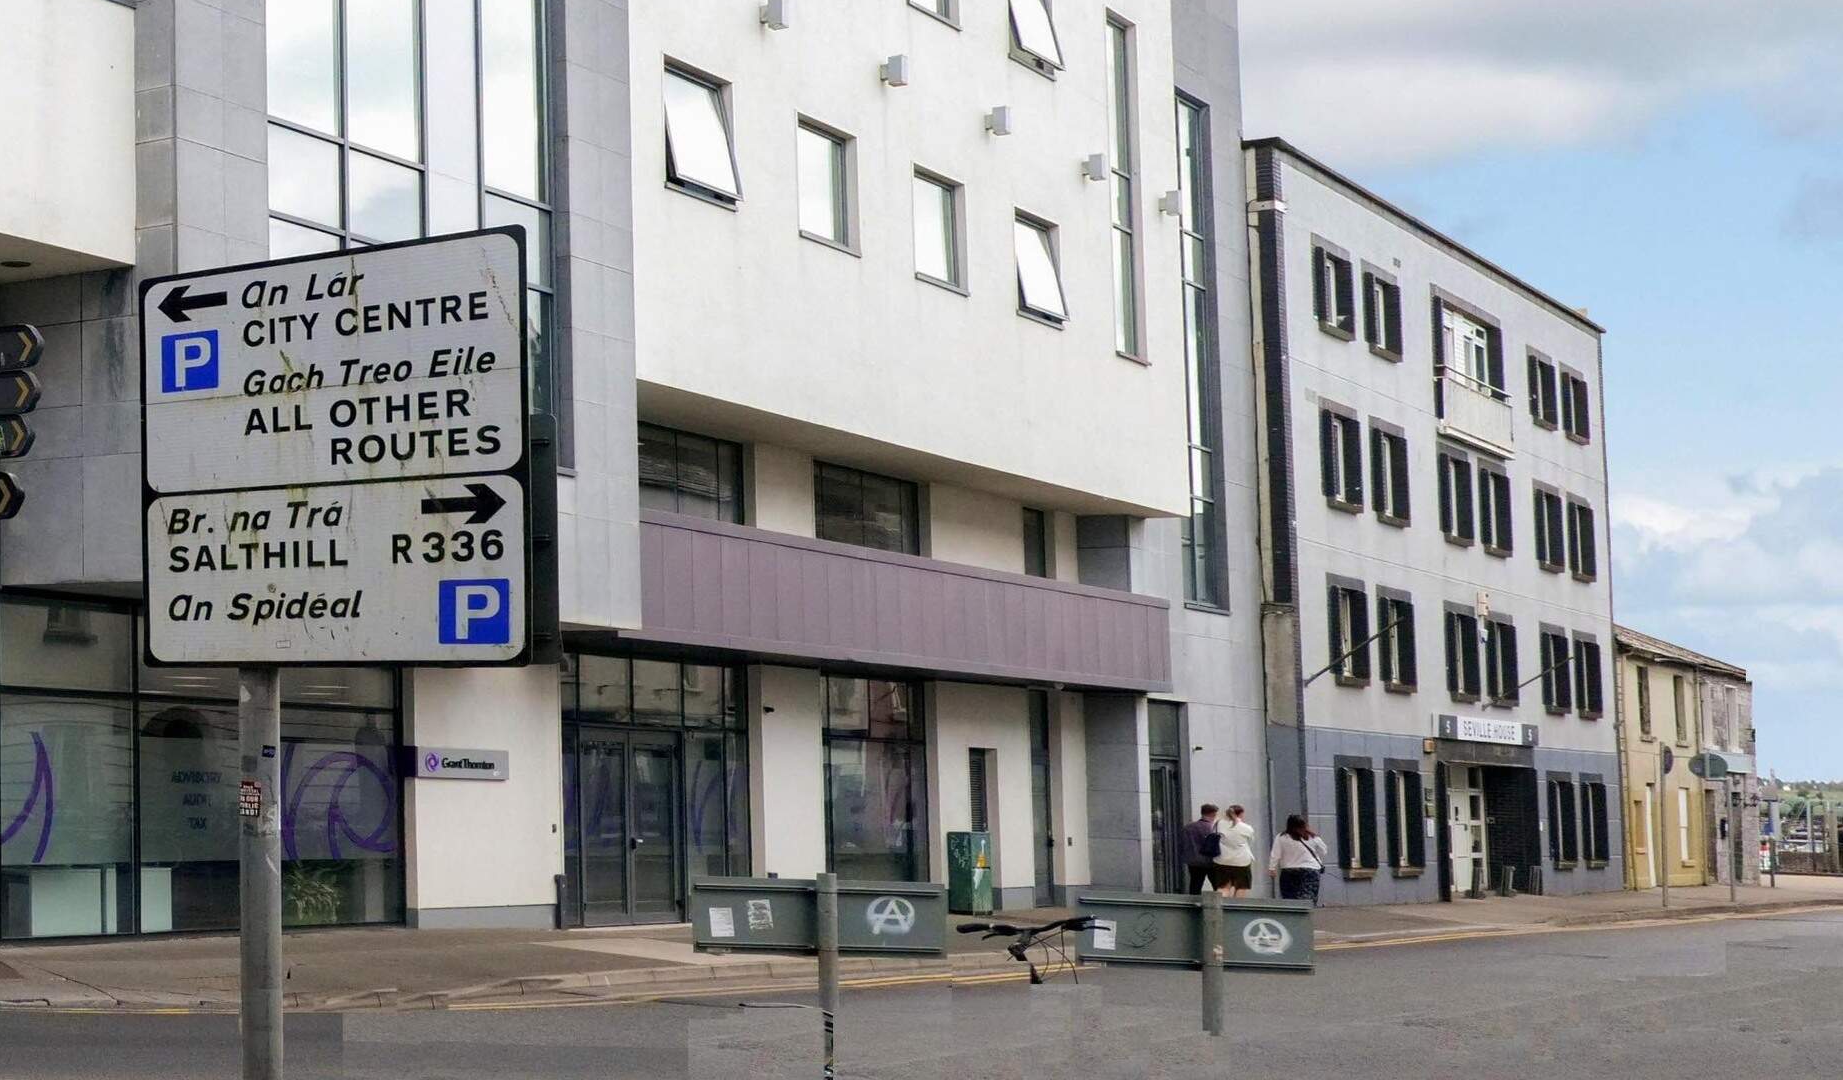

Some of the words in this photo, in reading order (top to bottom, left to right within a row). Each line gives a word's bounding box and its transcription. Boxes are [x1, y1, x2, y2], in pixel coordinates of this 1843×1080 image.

[241, 280, 288, 309] An
[305, 272, 365, 302] Lár
[243, 314, 319, 347] CITY
[335, 291, 489, 336] CENTRE
[174, 338, 211, 388] P
[244, 364, 325, 397] Gach
[340, 358, 413, 385] Treo
[429, 348, 496, 378] Eile
[244, 405, 313, 436] ALL
[329, 389, 471, 428] OTHER
[330, 425, 502, 465] ROUTES
[167, 508, 214, 535] Br.
[229, 510, 272, 533] na
[287, 500, 343, 528] Trá
[168, 540, 349, 573] SALTHILL
[168, 594, 214, 622] An
[226, 590, 363, 626] Spidéal
[455, 586, 501, 640] P
[441, 757, 463, 769] Grant
[462, 758, 495, 770] Thornton
